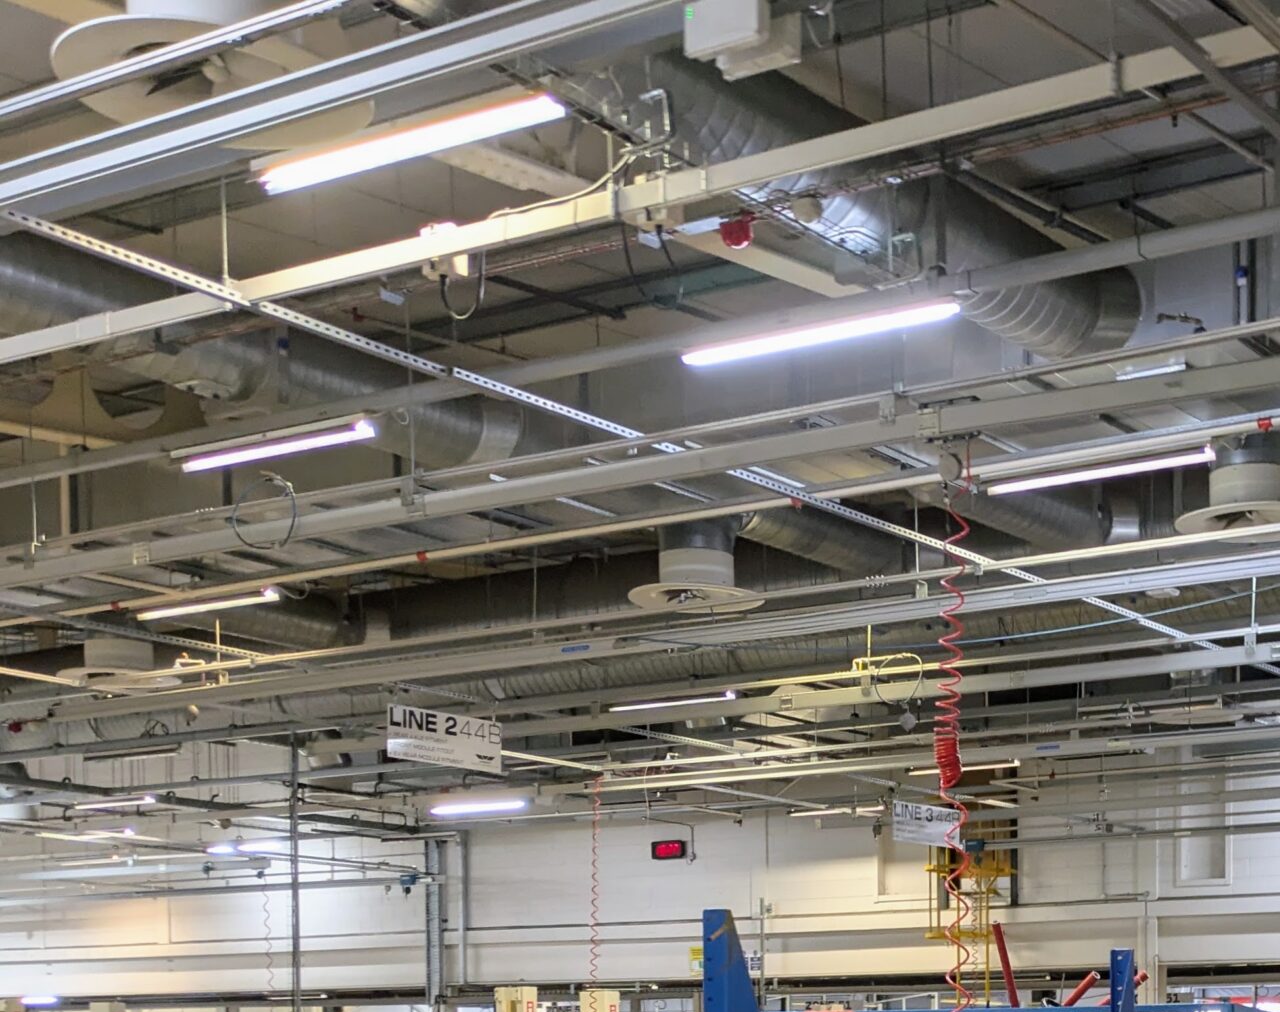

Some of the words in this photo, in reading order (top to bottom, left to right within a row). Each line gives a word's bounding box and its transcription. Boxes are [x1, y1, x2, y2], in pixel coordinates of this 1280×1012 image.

[389, 706, 438, 733] LINE
[445, 716, 458, 736] 2
[894, 802, 922, 820] LINE
[925, 807, 934, 822] 3
